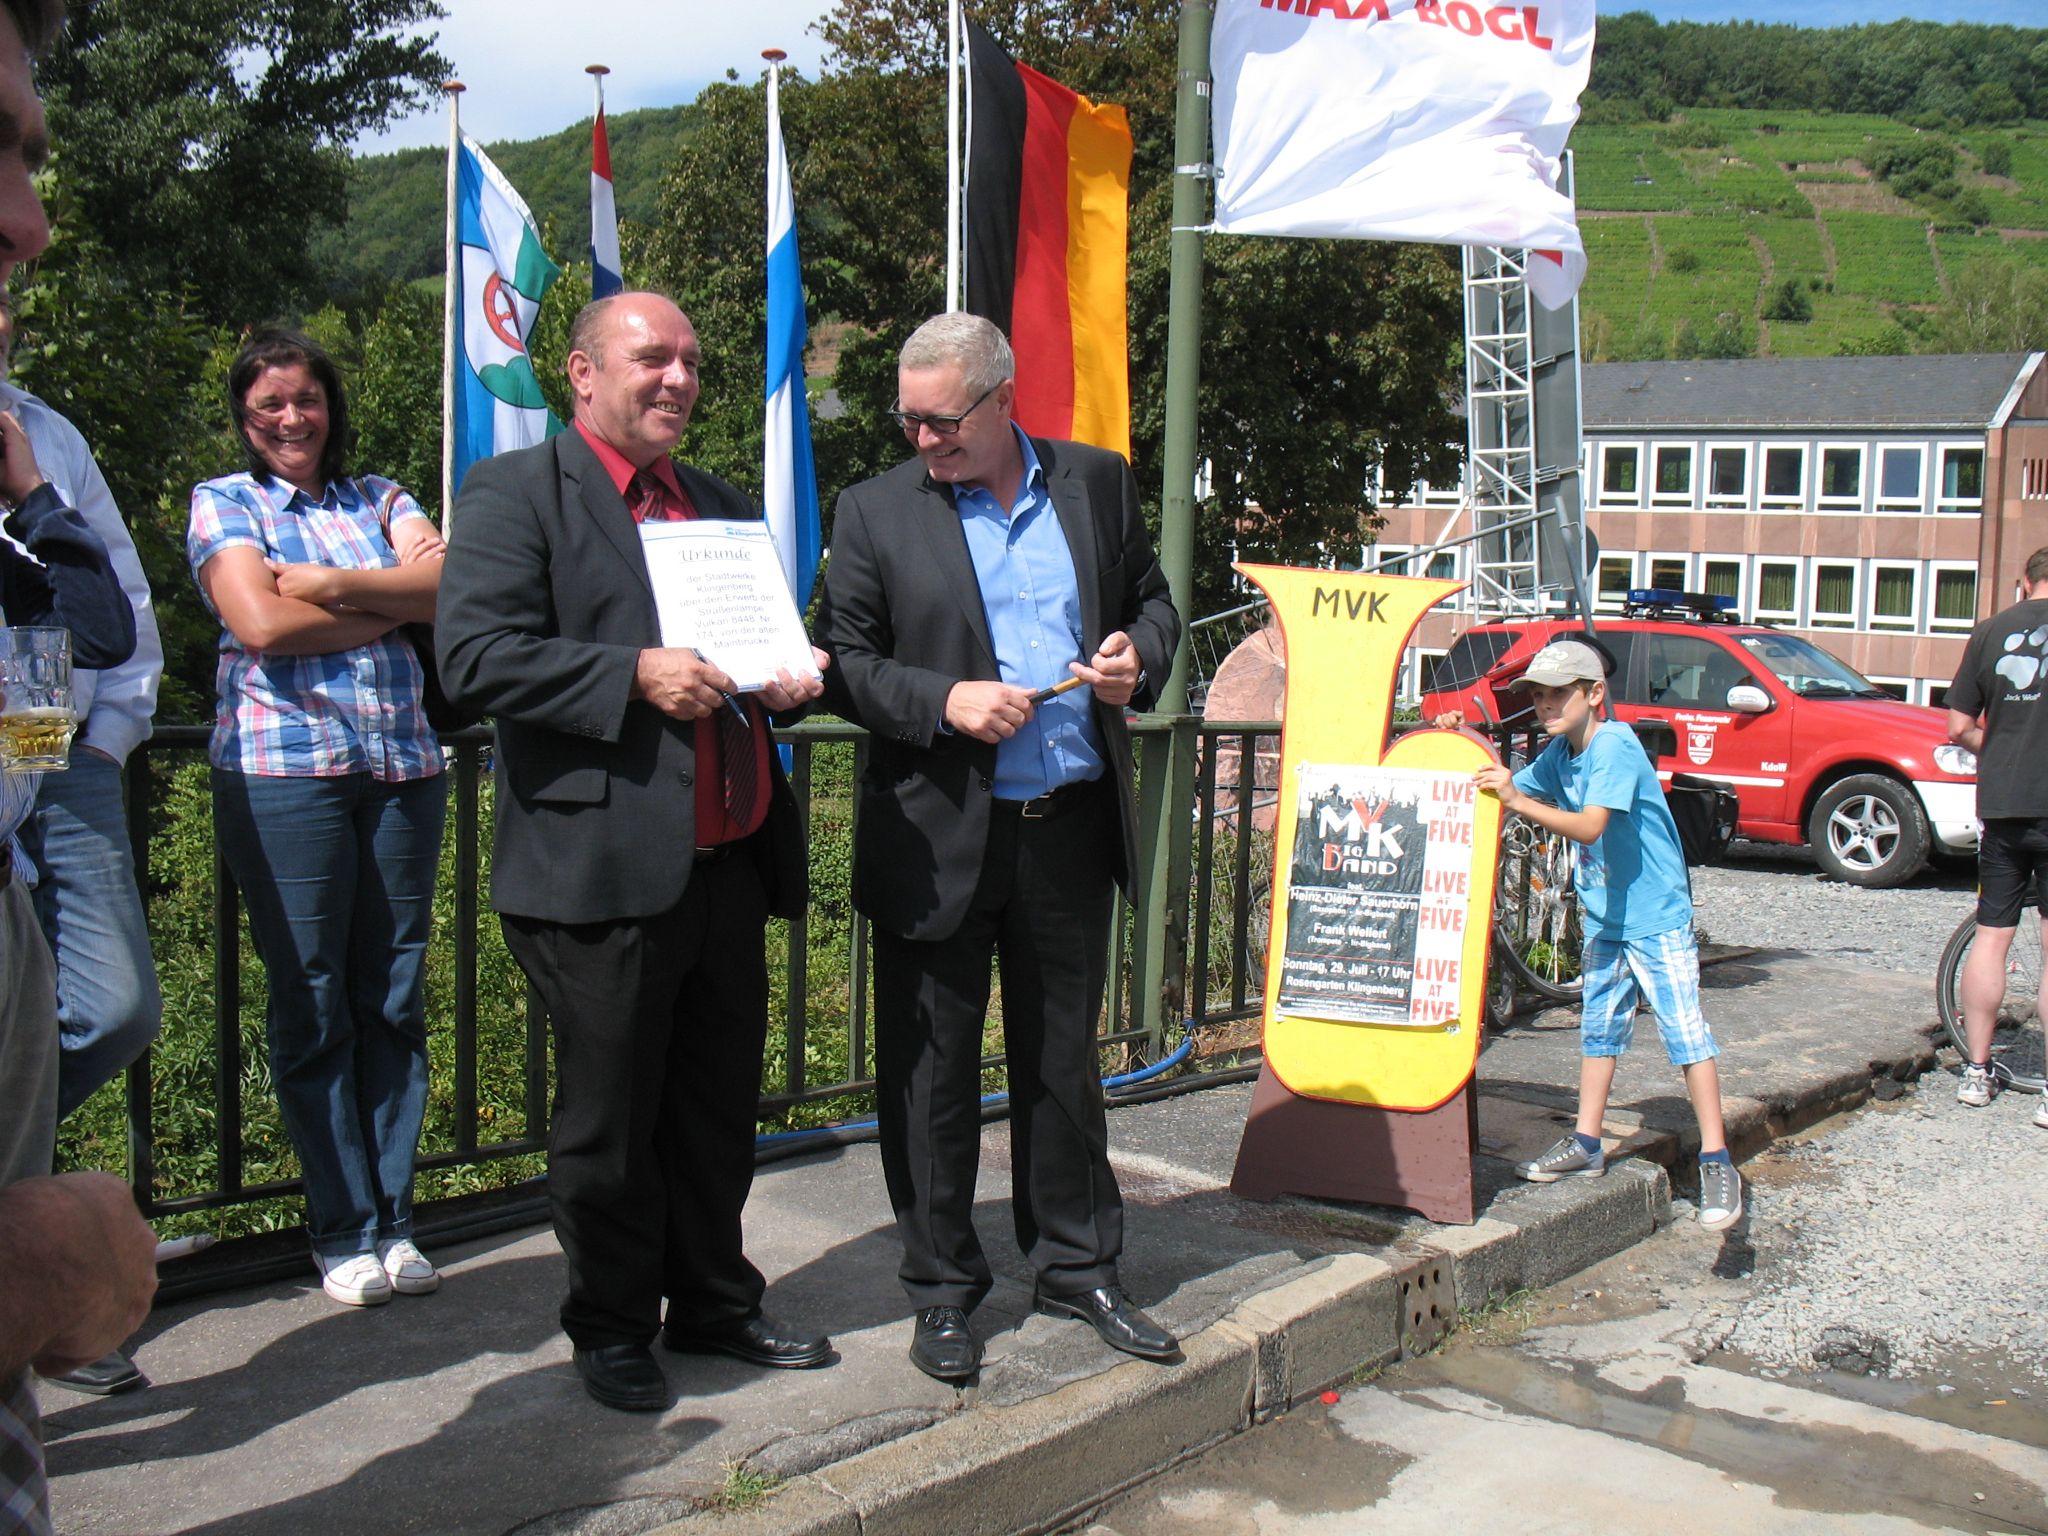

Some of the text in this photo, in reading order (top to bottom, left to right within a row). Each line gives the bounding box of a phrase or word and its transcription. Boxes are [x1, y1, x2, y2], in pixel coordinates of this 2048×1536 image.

[678, 547, 752, 562] Urkunde
[697, 583, 753, 593] Klingenberg
[705, 572, 756, 582] Stadtwerke
[704, 596, 722, 604] den
[725, 594, 758, 602] Erwerb
[760, 593, 774, 602] der
[1312, 587, 1389, 624] MVK
[1432, 780, 1474, 804] LIVE
[1445, 805, 1459, 818] AT
[1319, 799, 1404, 859] MVK
[1428, 820, 1471, 845] FIVE
[1424, 870, 1467, 895] LIVE
[1290, 887, 1418, 911] Heinz-Dieter Sauerborn
[1436, 897, 1450, 905] AT
[1313, 922, 1345, 936] Frank
[1420, 907, 1463, 932] FIVE
[1284, 956, 1328, 974] Sonntag,
[1330, 961, 1346, 974] 29.
[1348, 963, 1368, 976] Juli
[1377, 965, 1390, 978] 17
[1392, 966, 1413, 980] Uhr
[1415, 957, 1458, 983] LIVE
[1285, 975, 1405, 997] Rosengarten Klingenberg
[1428, 984, 1442, 998] AT
[1411, 999, 1455, 1021] FIVE
